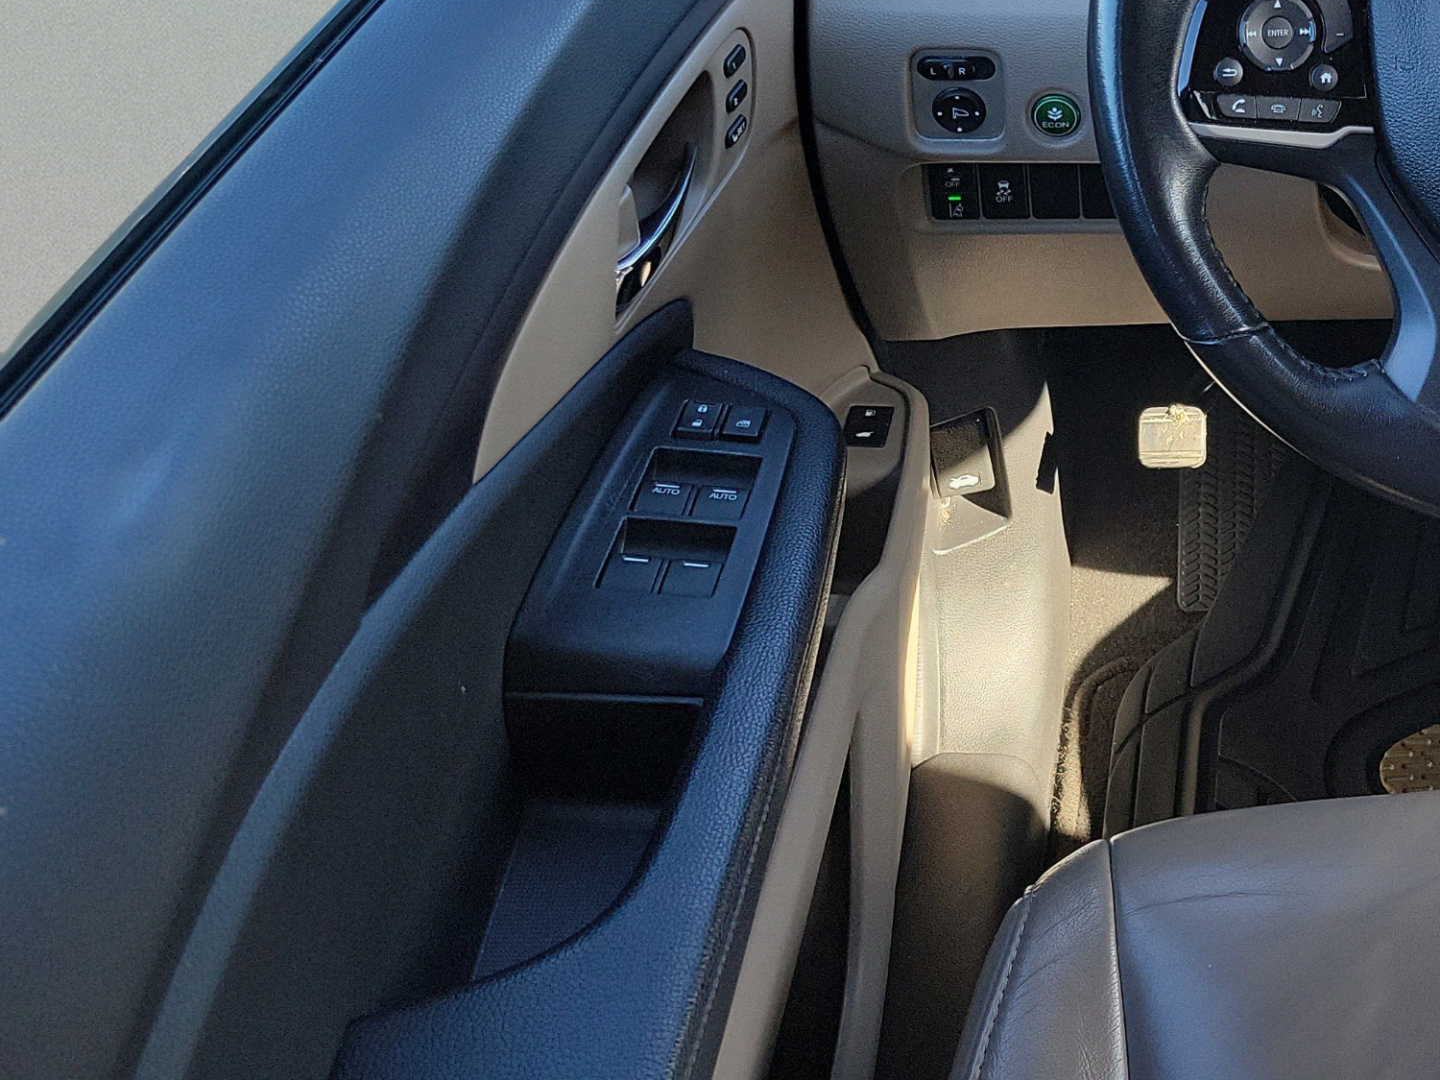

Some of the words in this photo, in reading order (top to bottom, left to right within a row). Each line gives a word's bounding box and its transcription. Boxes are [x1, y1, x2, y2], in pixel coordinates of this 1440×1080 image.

[1267, 29, 1289, 37] ENTER
[930, 67, 936, 75] L
[958, 67, 966, 75] R
[1042, 121, 1070, 129] ECON
[995, 195, 1014, 203] OFF
[652, 487, 681, 496] AUTO
[709, 492, 738, 501] AUTO
